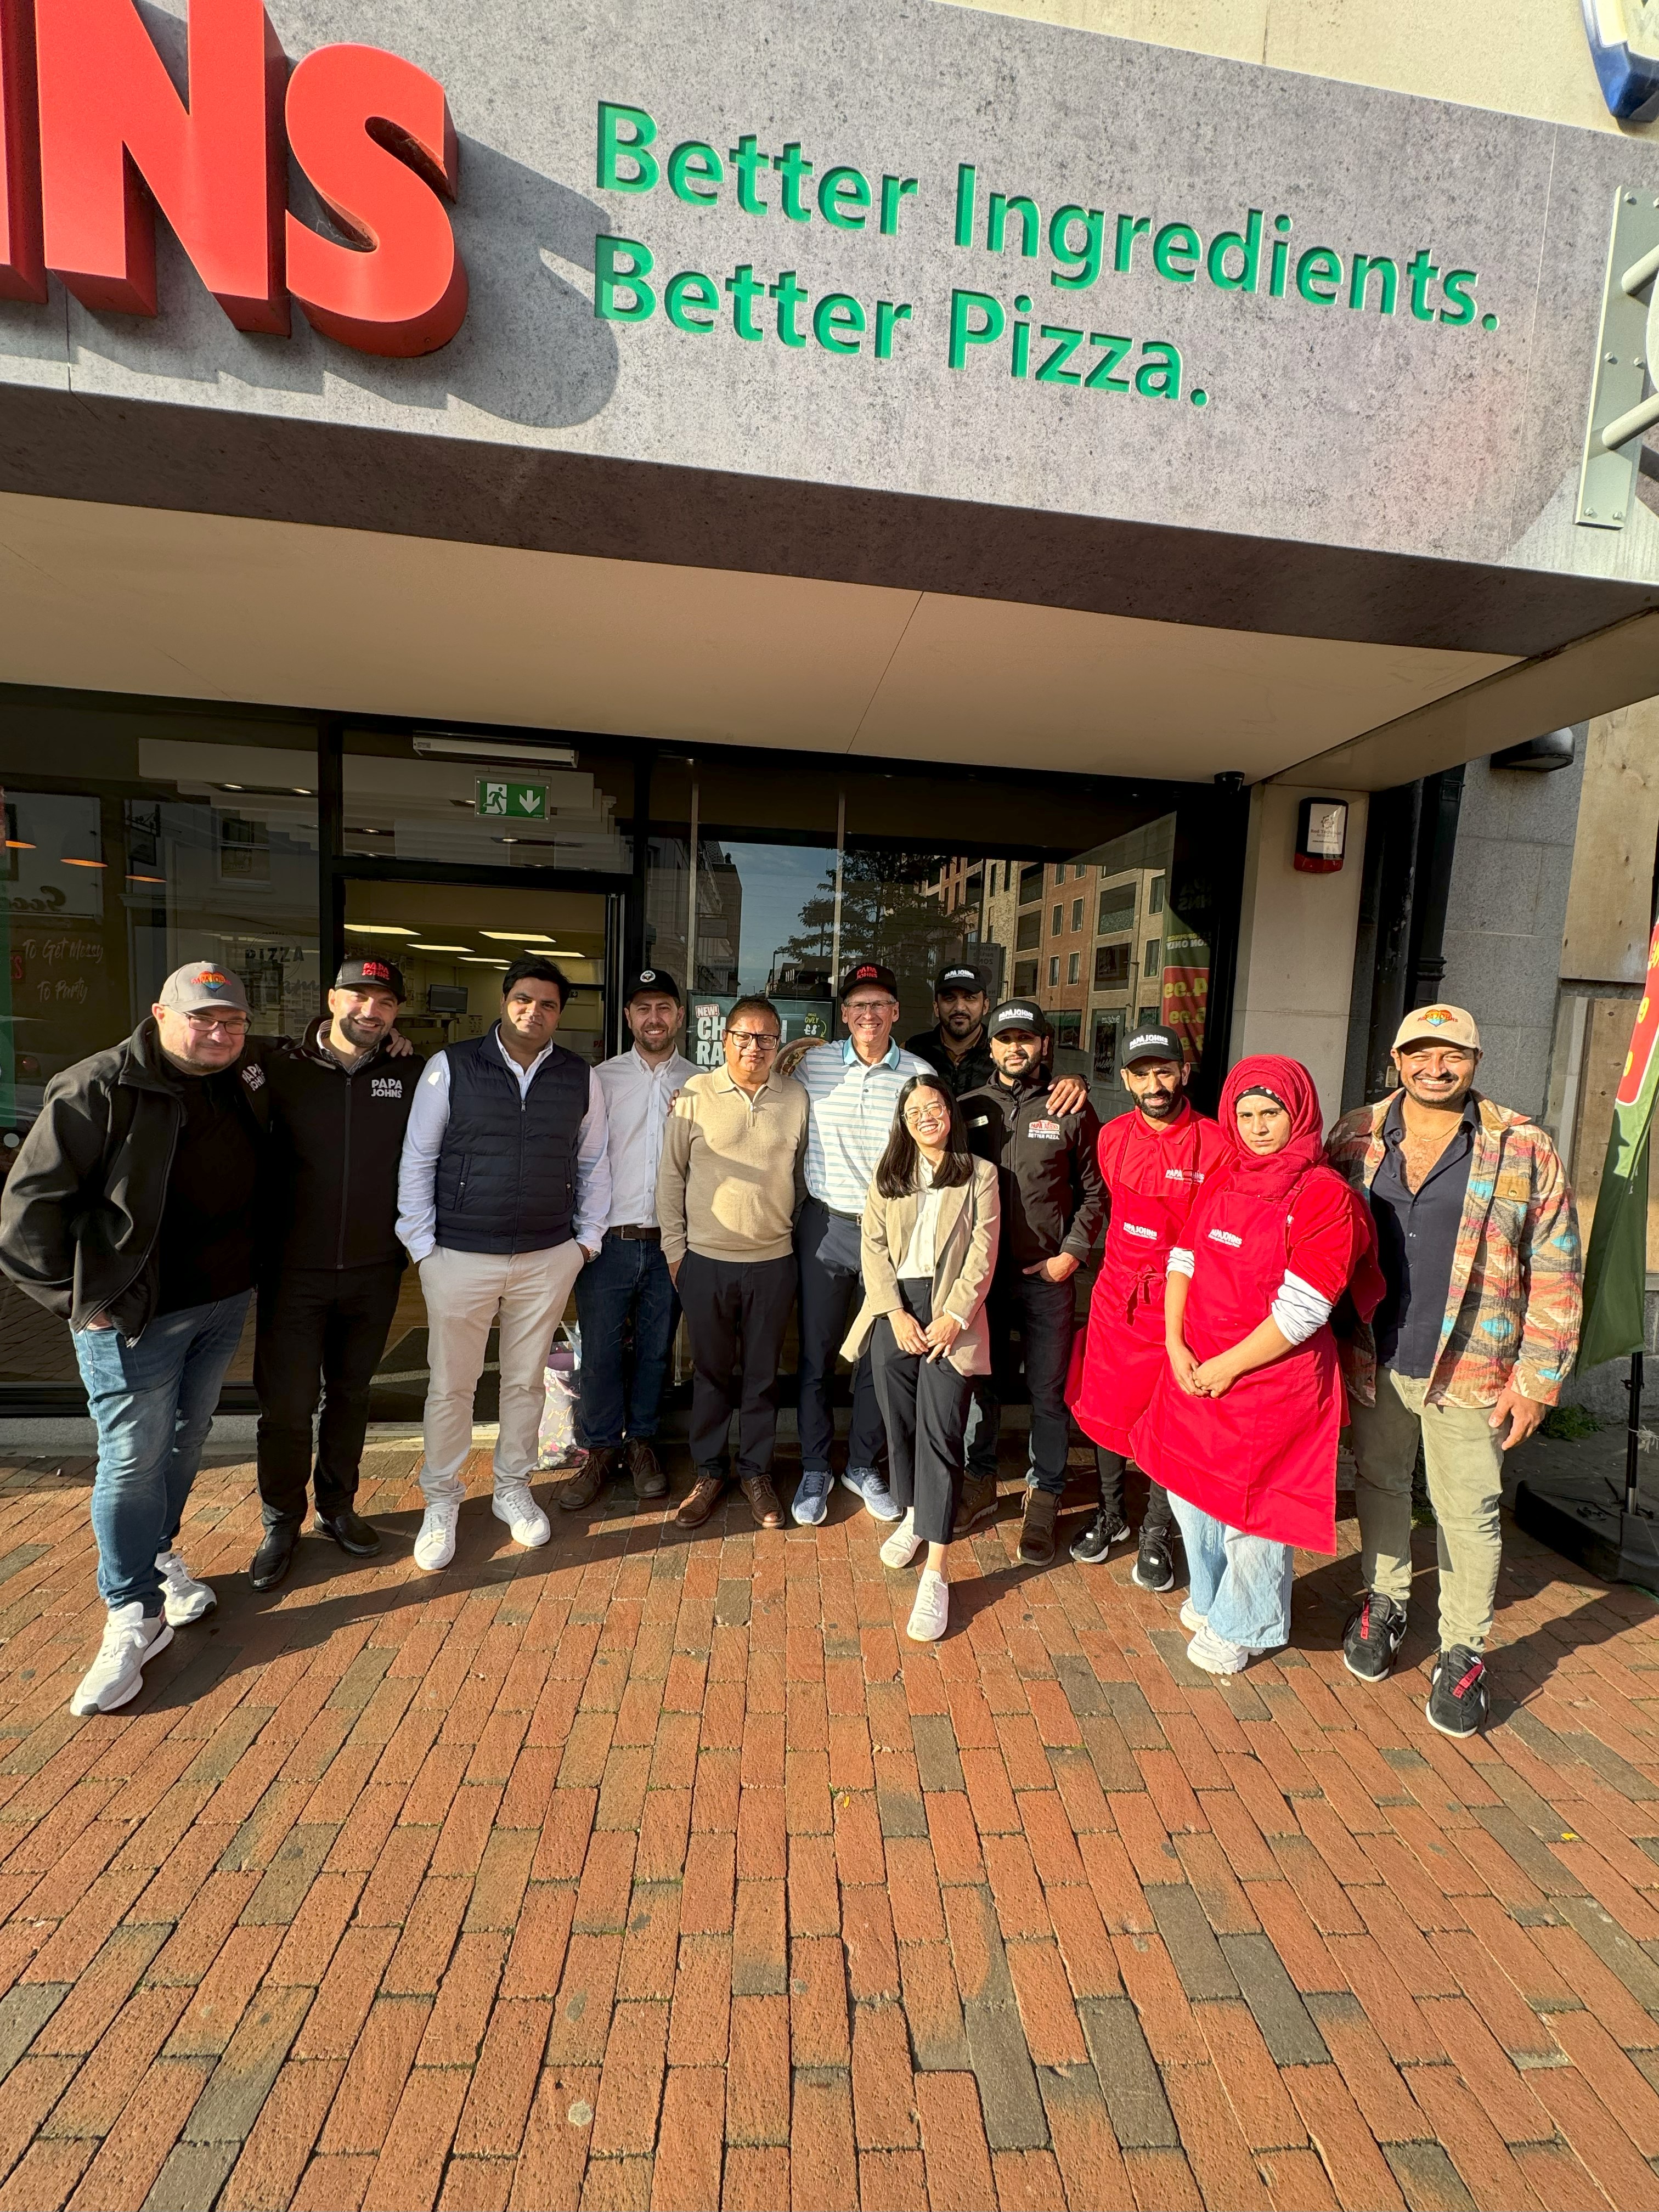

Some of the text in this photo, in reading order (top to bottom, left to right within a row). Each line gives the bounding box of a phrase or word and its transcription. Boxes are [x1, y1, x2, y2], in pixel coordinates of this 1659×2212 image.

[0, 0, 464, 346] NS
[596, 100, 1500, 331] Better Ingredients.
[594, 234, 1209, 408] Better Pizza.
[22, 939, 36, 960] To
[42, 937, 69, 966] Get
[363, 962, 389, 975] PAPA
[857, 966, 877, 975] PAPA
[697, 1006, 718, 1017] NEW!
[1130, 1035, 1144, 1047] PAPA
[1145, 1034, 1168, 1043] JOHNS
[371, 1078, 403, 1090] PAPA
[371, 1089, 402, 1098] JOHNS
[1166, 1169, 1183, 1179] PAPA
[1135, 1226, 1158, 1237] JOHNS
